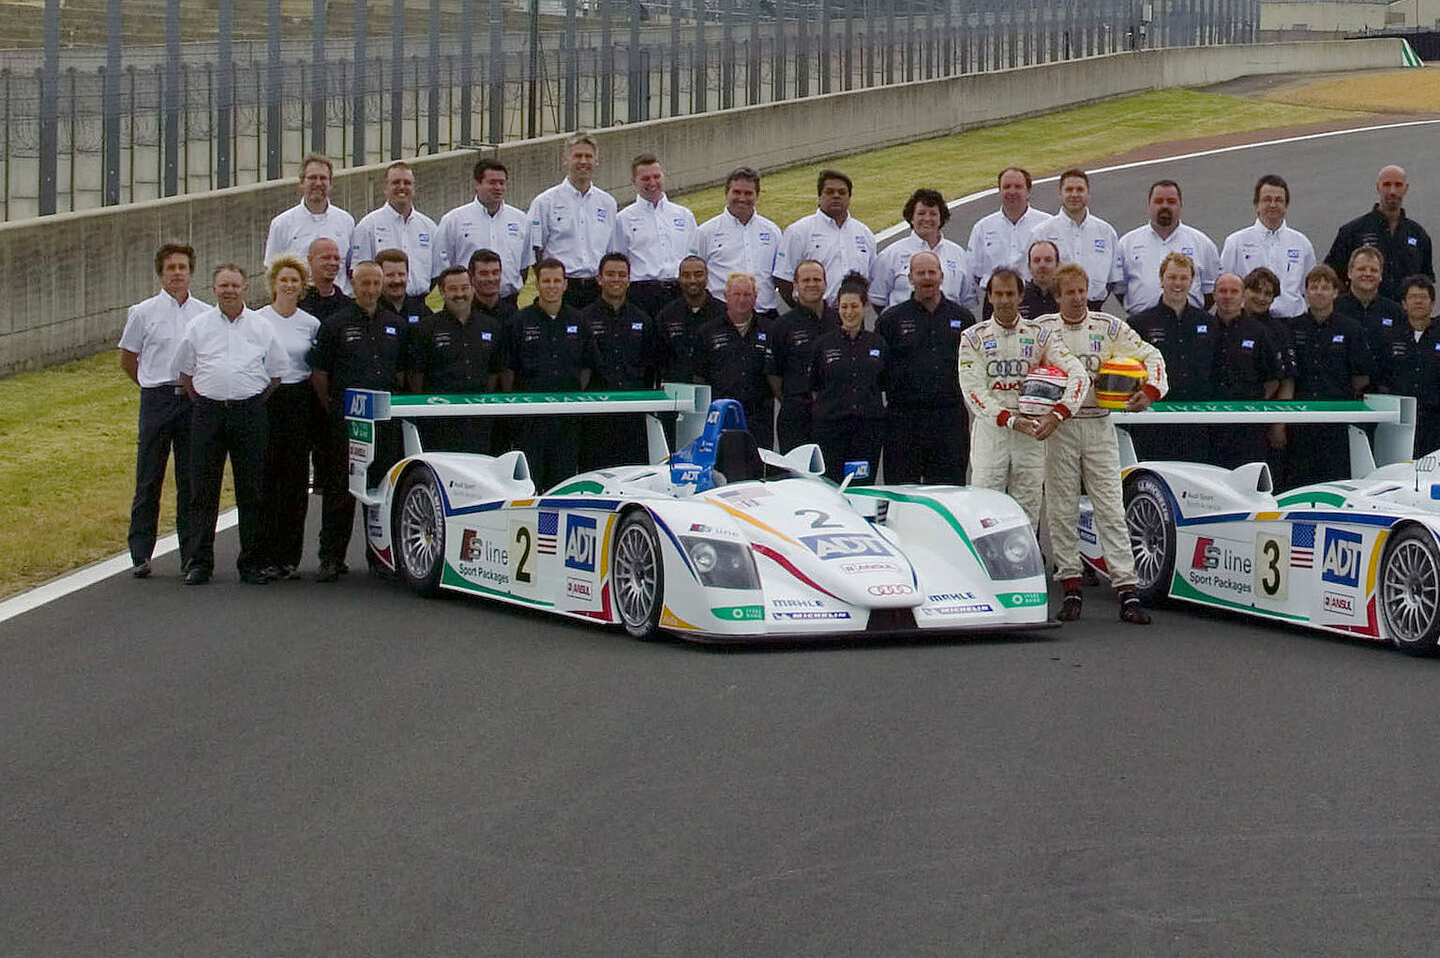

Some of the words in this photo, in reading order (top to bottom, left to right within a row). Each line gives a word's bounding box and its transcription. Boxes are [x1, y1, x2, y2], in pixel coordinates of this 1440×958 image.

[350, 393, 368, 417] ADT
[681, 470, 701, 481] ADT
[794, 509, 845, 529] 2
[486, 541, 509, 566] line
[516, 526, 531, 584] 2
[565, 525, 597, 565] ADT
[816, 537, 881, 557] ADT
[1224, 549, 1252, 574] line
[1262, 539, 1281, 596] 3
[1322, 537, 1363, 580] ADT
[459, 564, 477, 578] Sport
[478, 567, 510, 585] Packages
[1189, 571, 1212, 587] Sport
[1213, 576, 1252, 593] Packages
[772, 599, 824, 608] MAHLE
[928, 592, 976, 602] MAHLE
